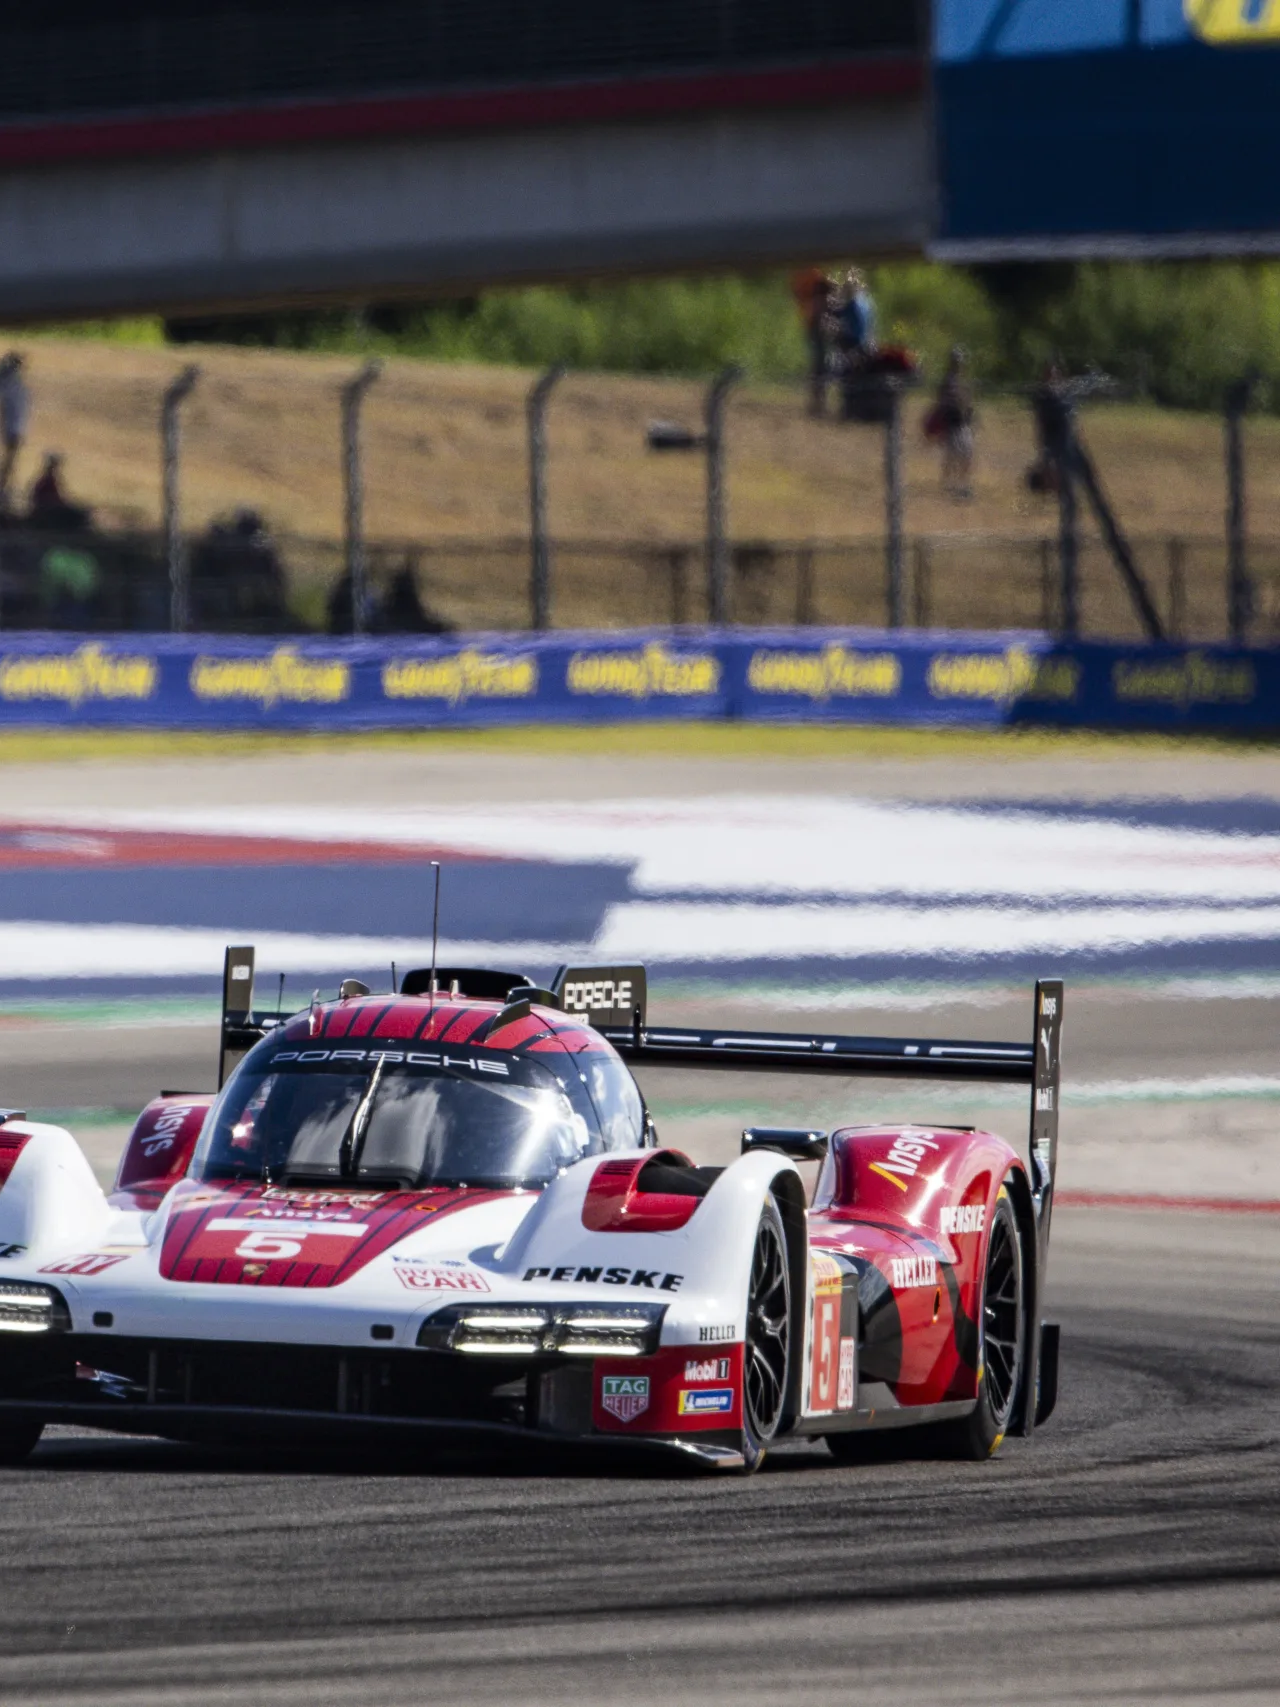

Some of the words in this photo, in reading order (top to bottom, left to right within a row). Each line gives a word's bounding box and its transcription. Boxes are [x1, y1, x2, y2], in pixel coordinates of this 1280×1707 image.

[564, 981, 632, 1009] PORSCHE
[270, 1050, 510, 1075] PORSCHE
[868, 1131, 940, 1192] Ansys
[940, 1204, 986, 1234] PENSKE
[235, 1231, 308, 1260] 5
[407, 1276, 483, 1290] CAR
[522, 1266, 685, 1292] PENSKE
[890, 1256, 937, 1288] HELLER
[699, 1325, 736, 1341] HELLER
[819, 1303, 833, 1401] 5
[684, 1359, 718, 1381] Mobil
[606, 1380, 646, 1393] TAG
